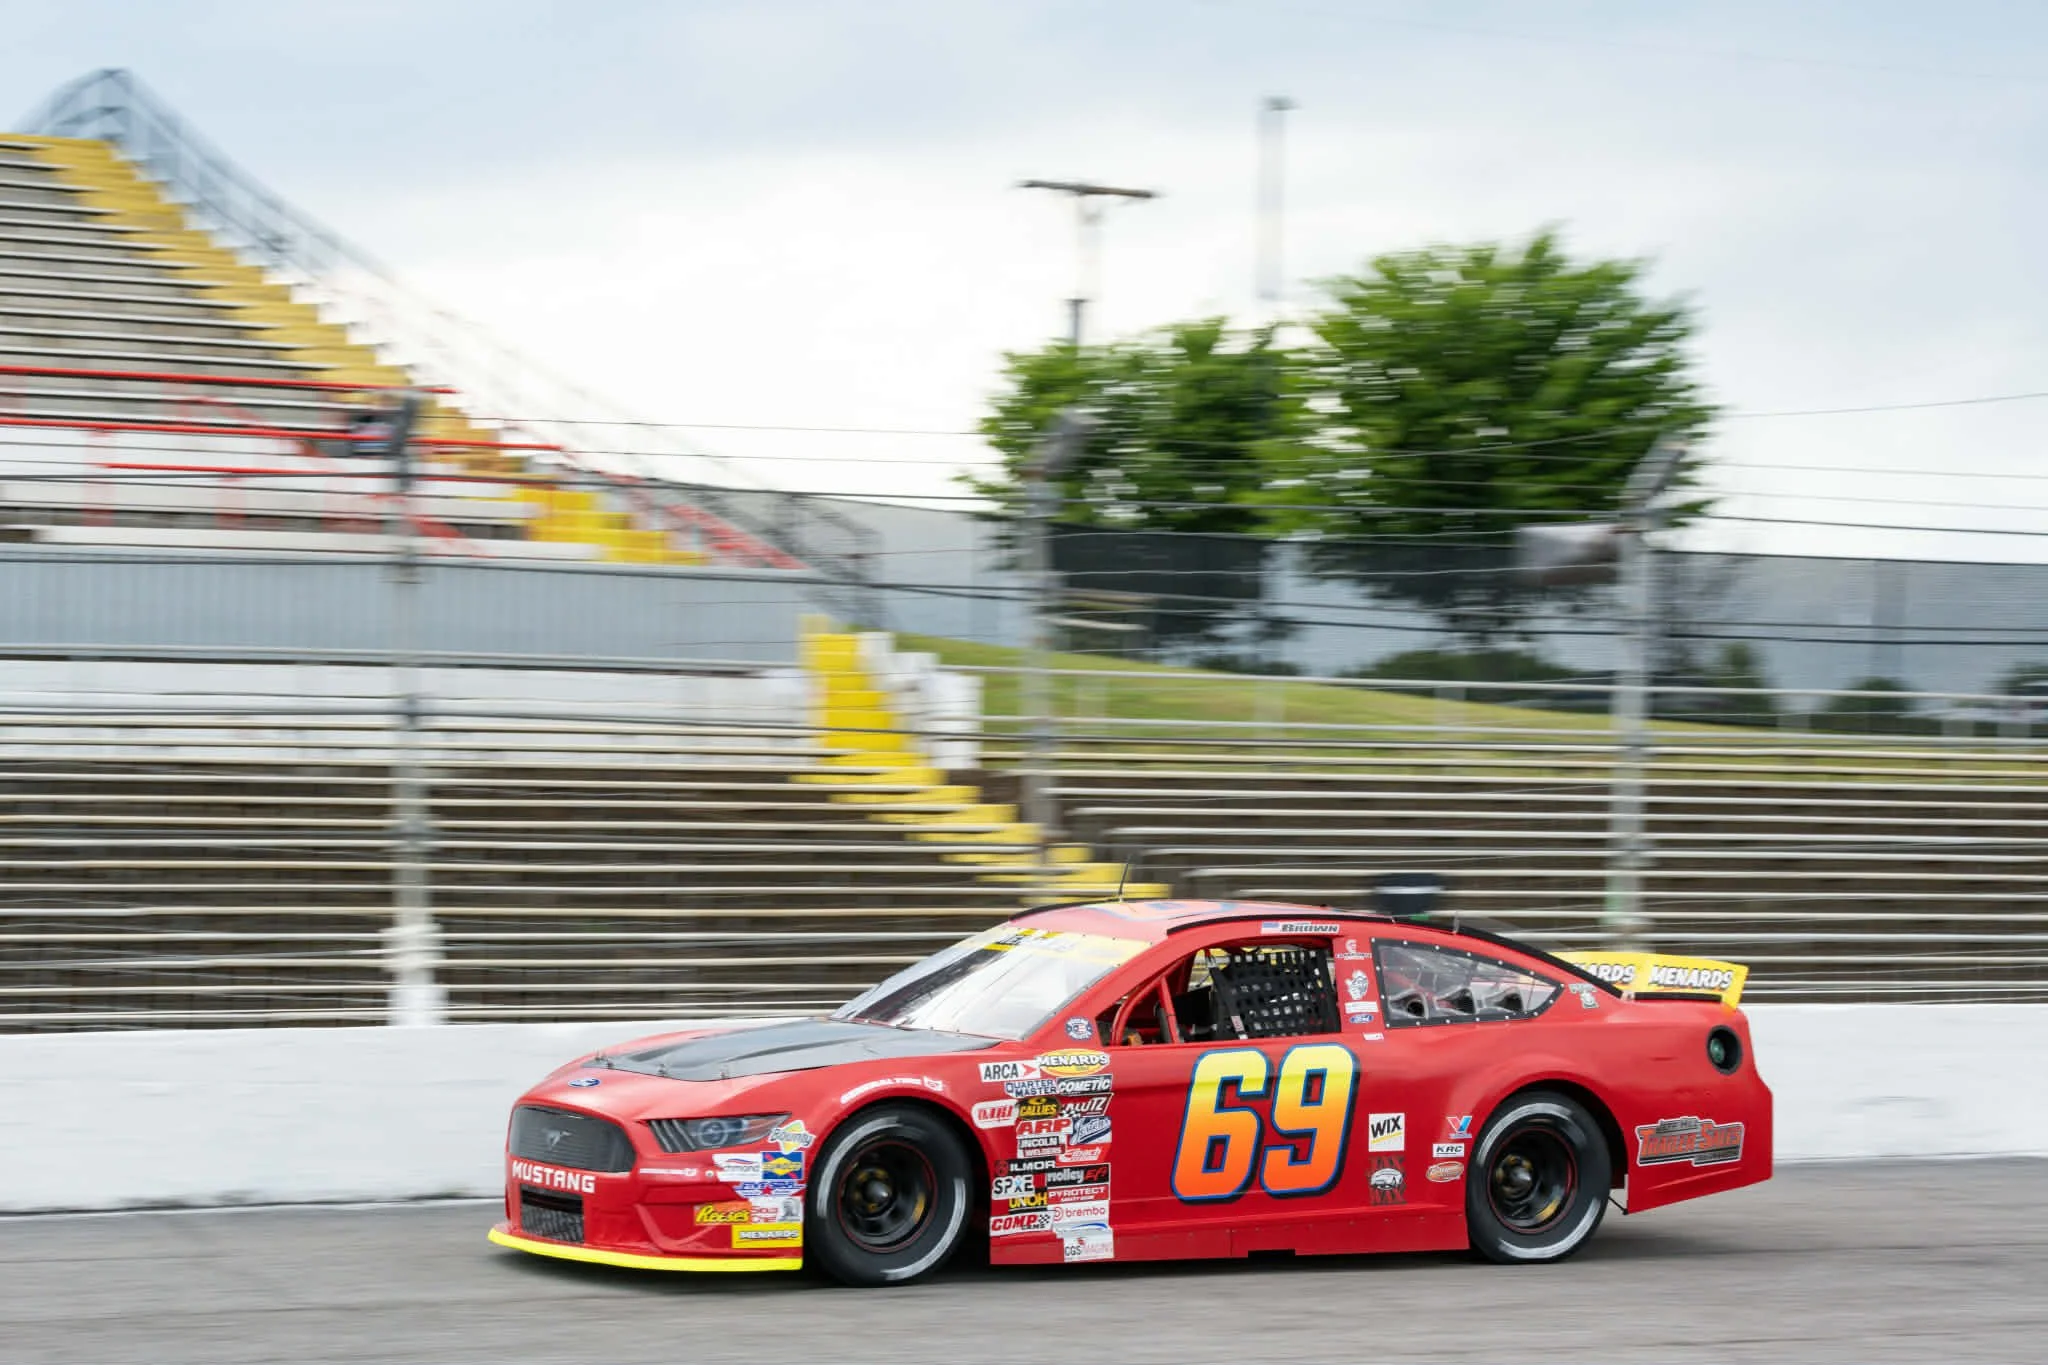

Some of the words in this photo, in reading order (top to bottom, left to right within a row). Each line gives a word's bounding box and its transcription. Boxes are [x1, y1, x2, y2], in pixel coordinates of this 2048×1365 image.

[1574, 962, 1637, 983] ARDS
[1650, 965, 1734, 989] MENARDS
[1033, 1053, 1111, 1067] MENARDS
[983, 1063, 1019, 1081] ARCA
[1005, 1080, 1055, 1094] QUARTER
[1015, 1087, 1057, 1098] MASTER
[1060, 1078, 1111, 1094] COMETIC
[1017, 1120, 1071, 1135] ARP
[1170, 1042, 1361, 1205] 69
[1370, 1115, 1402, 1138] WIX
[1436, 1145, 1462, 1153] KRC
[1009, 1160, 1057, 1172] ILMOR
[511, 1160, 596, 1194] MUSTANG
[1048, 1186, 1105, 1199] PYROTECT
[1008, 1192, 1048, 1209] UNOH
[1065, 1206, 1106, 1217] brembo
[991, 1214, 1038, 1231] COMP
[740, 1229, 799, 1240] MENARDS
[1064, 1245, 1082, 1257] CGS
